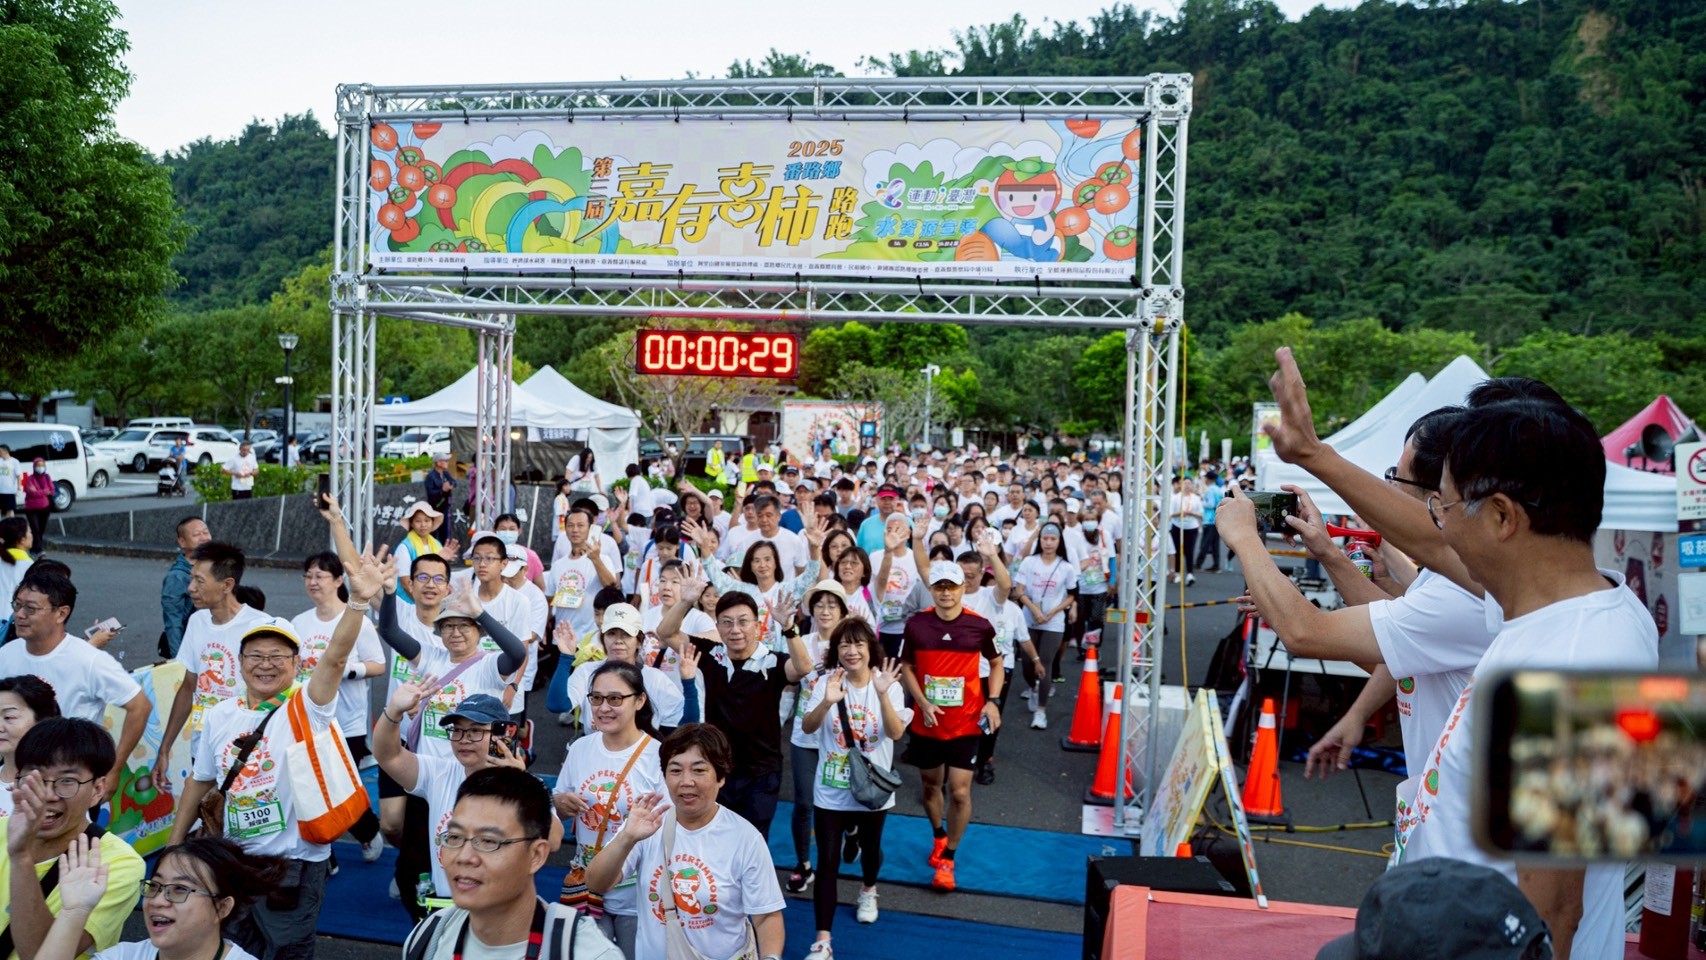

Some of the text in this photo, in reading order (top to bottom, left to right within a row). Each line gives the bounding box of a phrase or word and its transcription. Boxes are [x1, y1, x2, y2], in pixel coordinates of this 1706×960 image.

[787, 139, 845, 158] 2025
[784, 161, 843, 181] 番路鄉
[579, 162, 823, 247] 嘉有喜柿
[823, 186, 859, 241] 路跑
[645, 335, 793, 373] 00:00:29
[207, 642, 235, 677] PERSIMMON
[598, 769, 634, 812] PERSMMON
[243, 807, 271, 822] 3100
[675, 854, 718, 903] PERSIMMON
